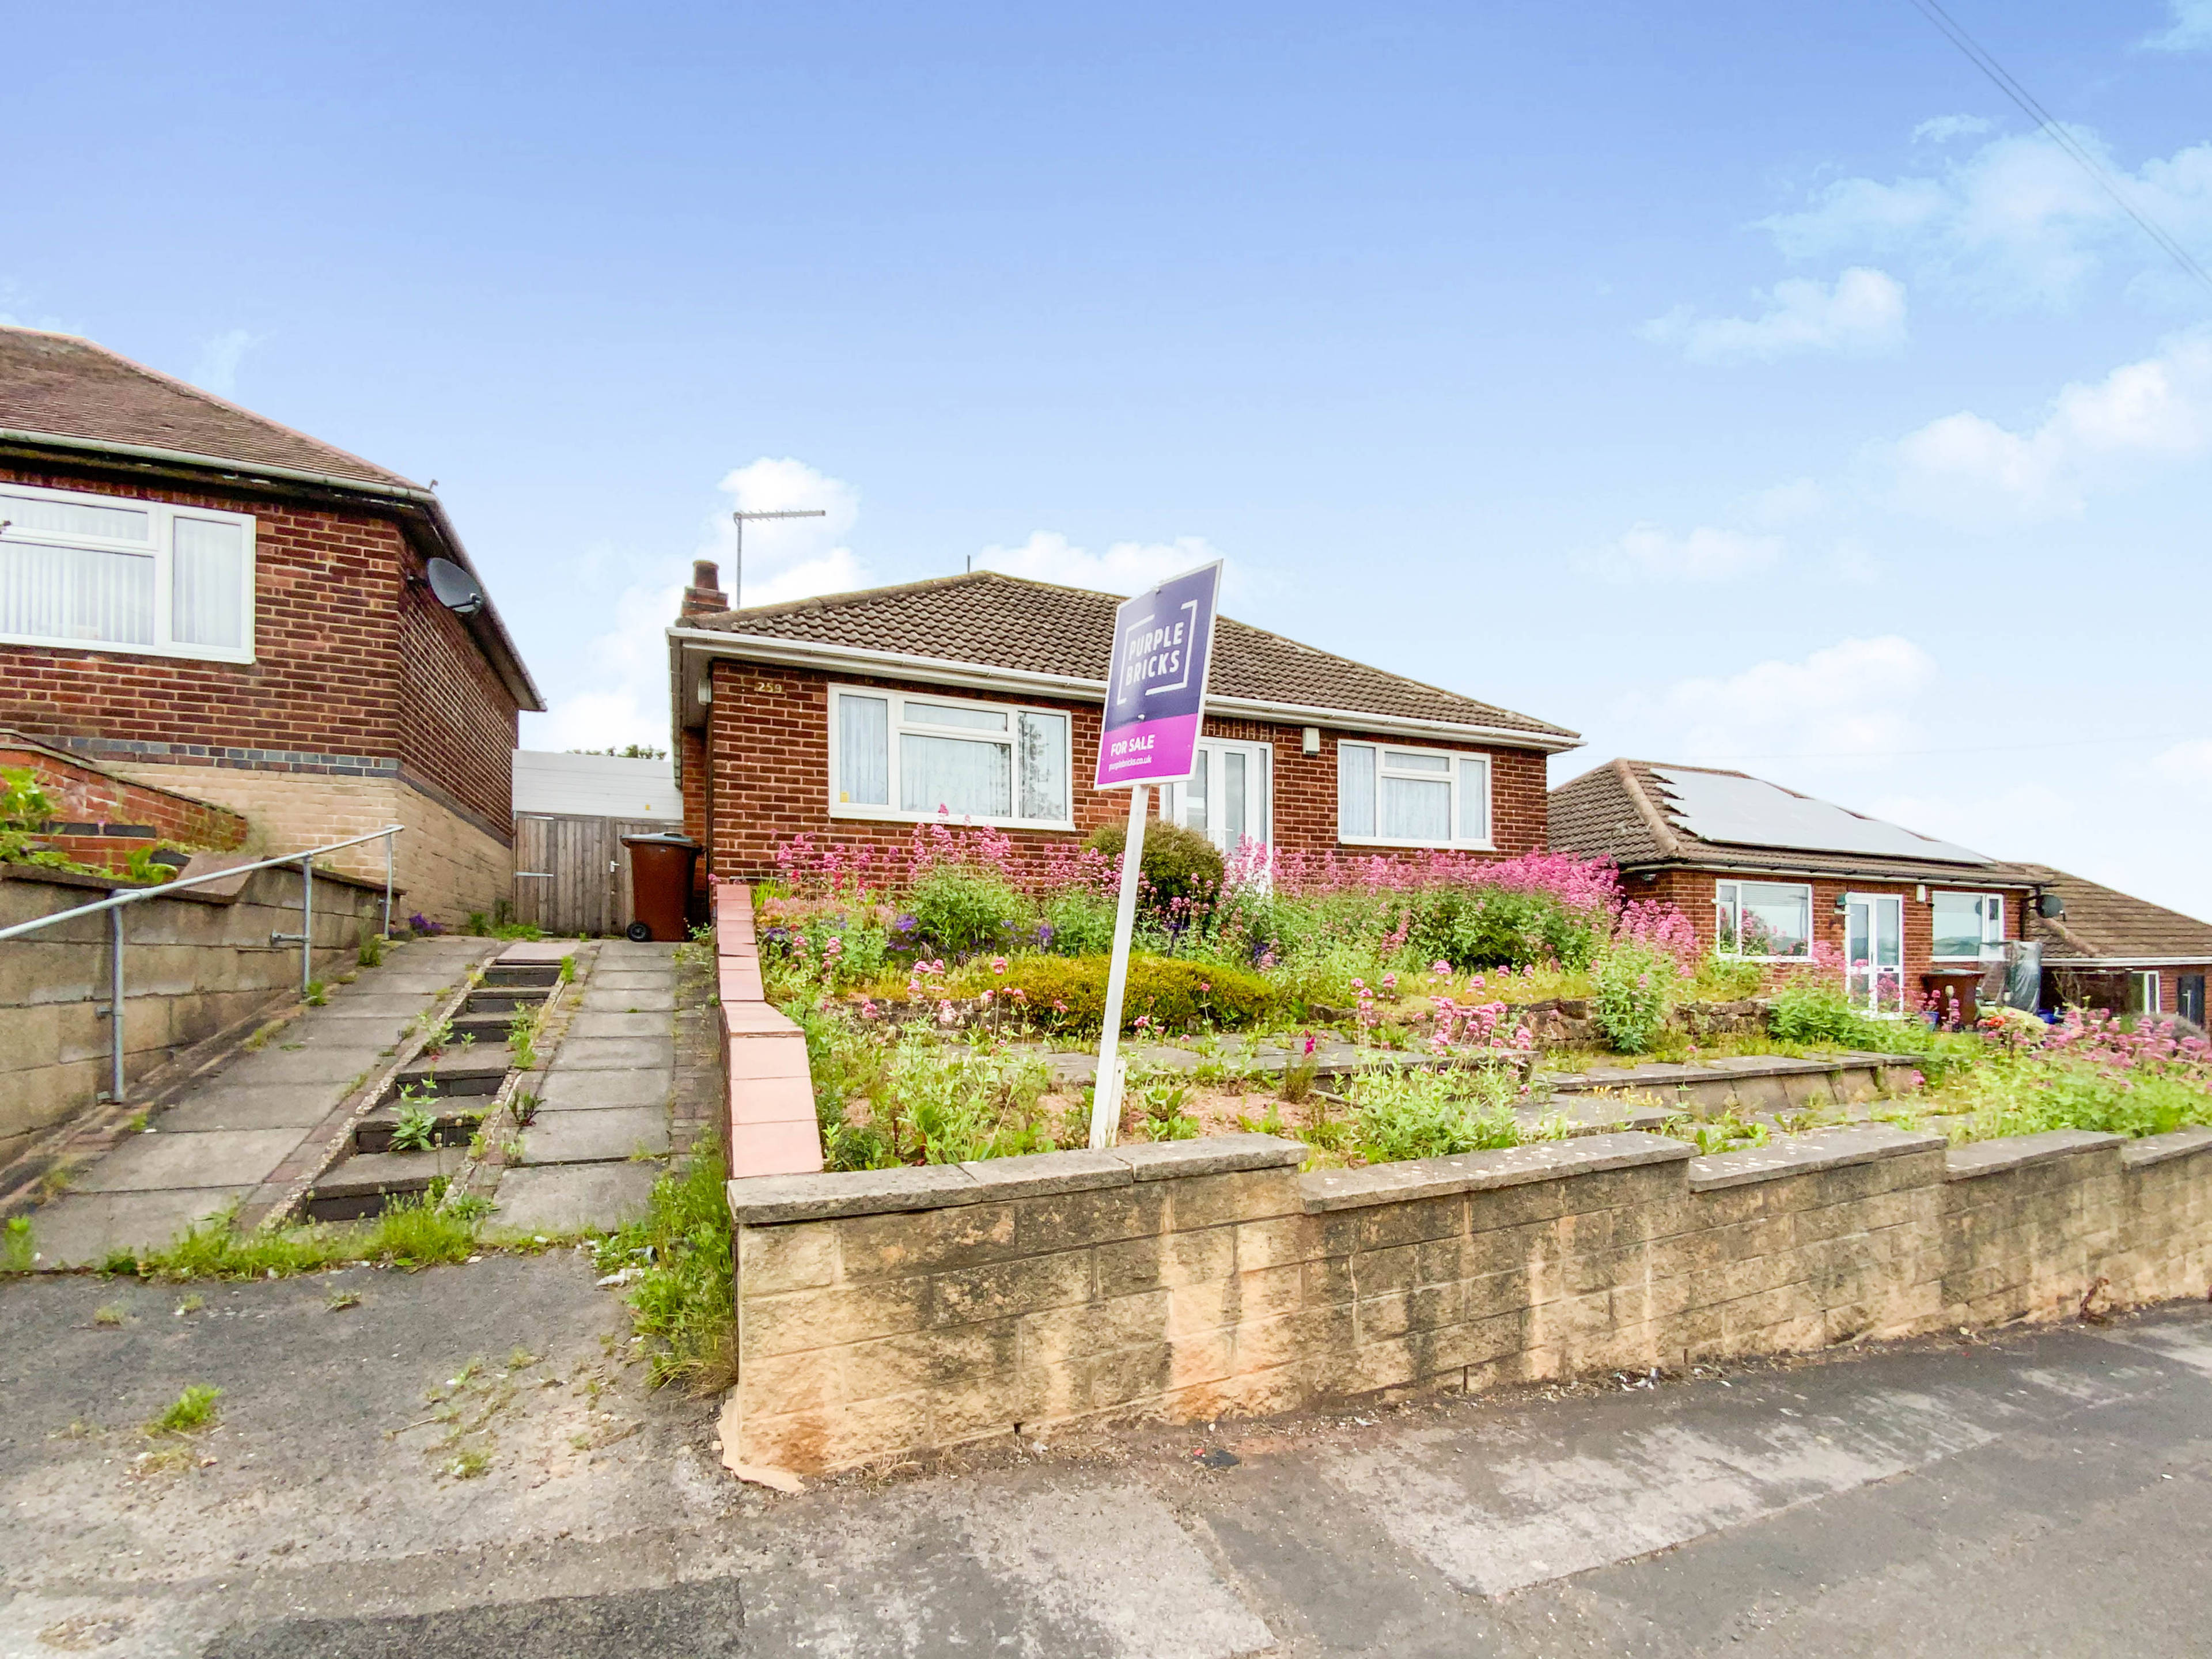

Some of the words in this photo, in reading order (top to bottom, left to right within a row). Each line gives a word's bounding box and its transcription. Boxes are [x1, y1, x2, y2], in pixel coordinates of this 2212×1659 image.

[1128, 622, 1184, 660] PURPLE
[1126, 650, 1180, 686] BRICKS
[1111, 740, 1127, 756] FOR
[1129, 734, 1155, 752] SALE
